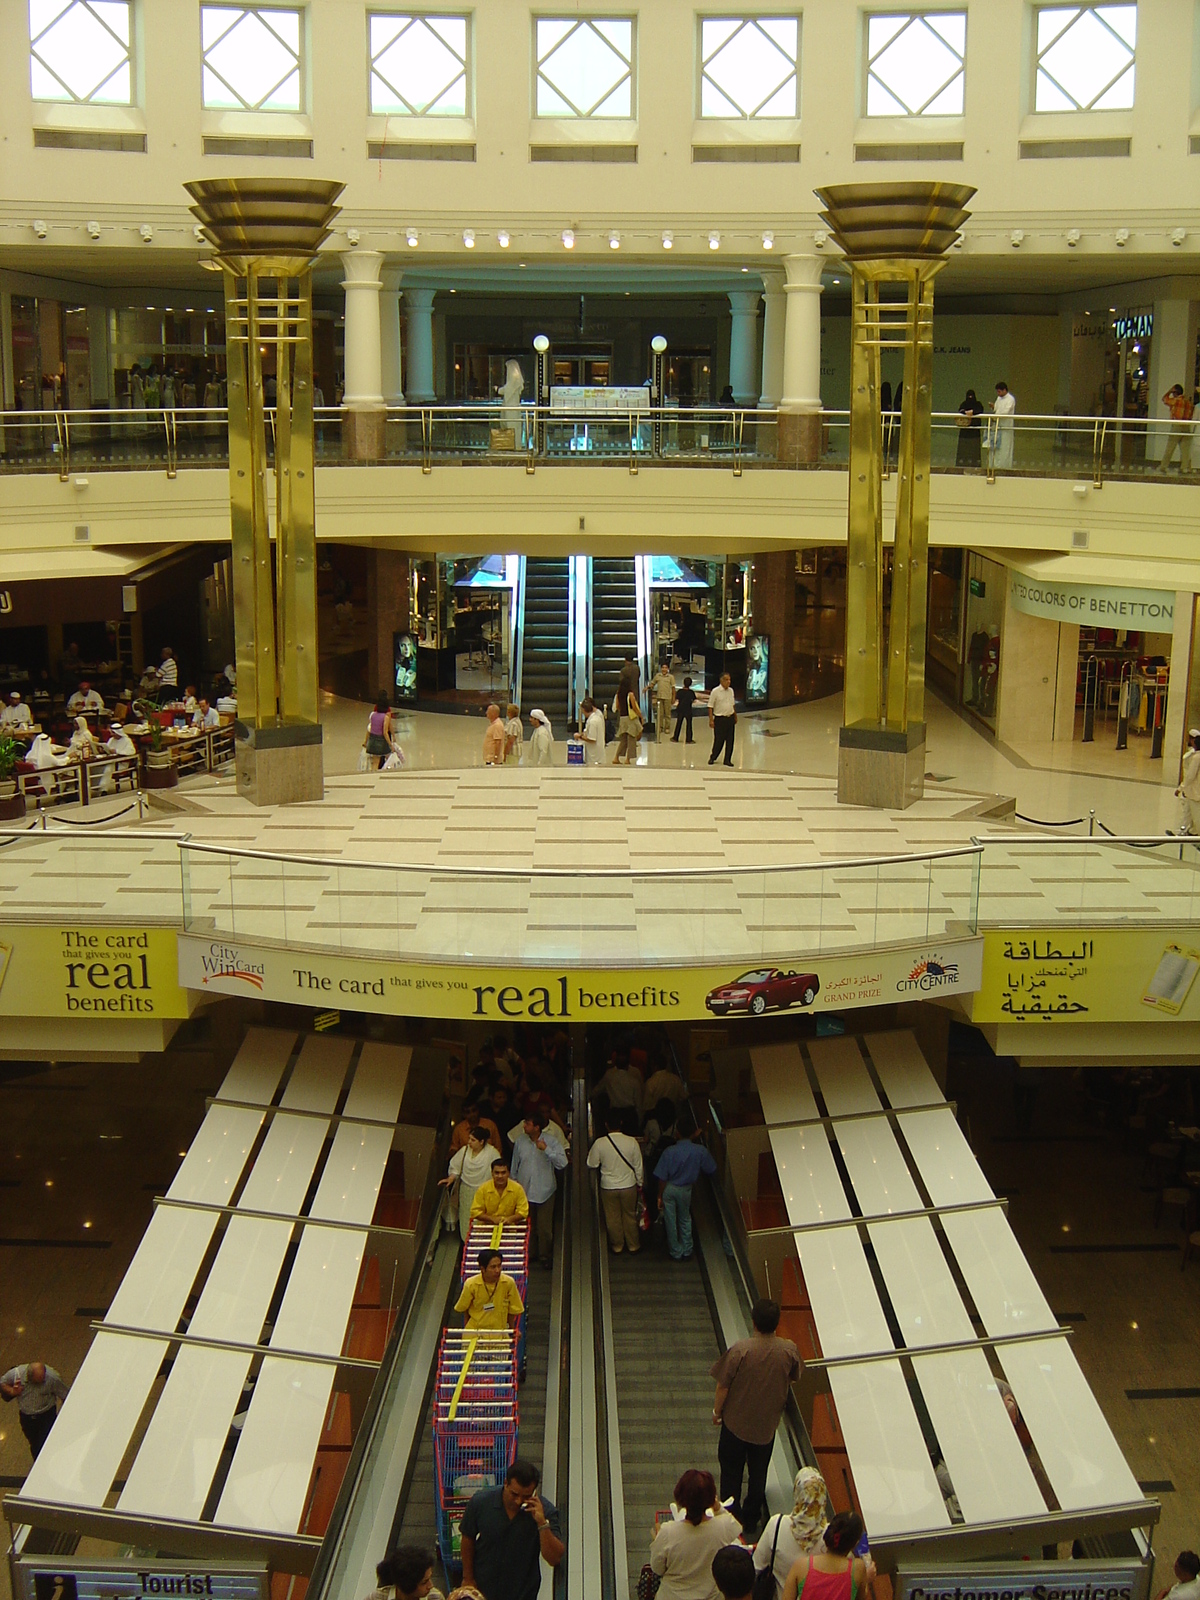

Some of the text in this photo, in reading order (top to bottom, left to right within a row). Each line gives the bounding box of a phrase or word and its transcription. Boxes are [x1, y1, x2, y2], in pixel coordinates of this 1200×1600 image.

[1114, 314, 1154, 339] TOPMAN
[948, 346, 971, 354] JEANS
[1028, 588, 1066, 607] COLORS
[1068, 595, 1086, 610] OF
[1089, 598, 1174, 618] BENETTON
[61, 931, 149, 949] The card
[62, 949, 132, 961] that gives you
[210, 943, 238, 963] City
[1003, 939, 1094, 966] البطاقة
[65, 953, 152, 990] real
[853, 973, 883, 987] الجائزة
[1035, 967, 1068, 977] تمنحك
[292, 969, 680, 1017] The card that gives you real benefits
[1008, 973, 1047, 993] مزايا
[65, 993, 154, 1012] benefits
[823, 988, 882, 1003] GRAND PRIZE
[1001, 992, 1089, 1021] حقيقية
[137, 1571, 214, 1595] Tourist
